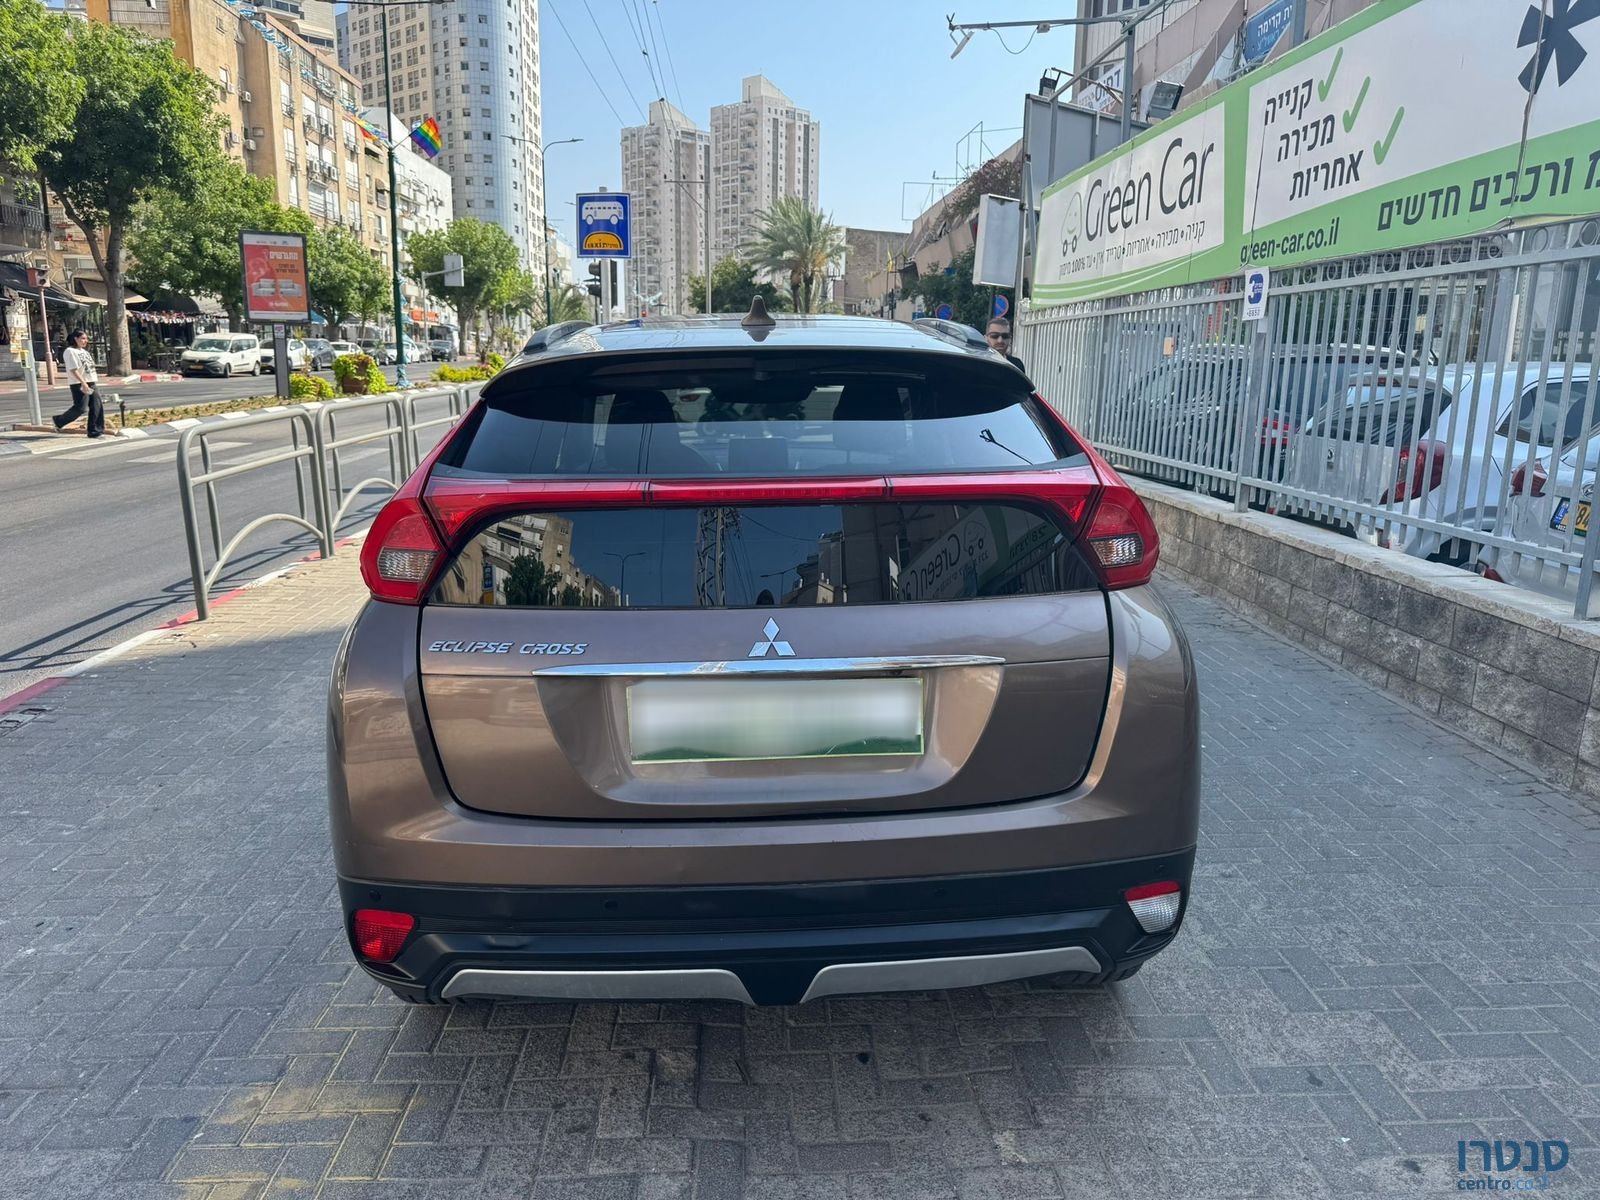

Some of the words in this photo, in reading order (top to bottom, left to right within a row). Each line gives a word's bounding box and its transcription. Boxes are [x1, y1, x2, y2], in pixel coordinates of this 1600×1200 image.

[1257, 11, 1282, 37] קדימה
[1264, 78, 1313, 126] קנייה
[1277, 114, 1335, 162] מכירה
[1085, 172, 1152, 242] Green
[1159, 137, 1215, 215] Car
[1289, 150, 1364, 201] אחריות
[1469, 157, 1574, 213] ורכבים
[1377, 184, 1461, 231] חדשים
[428, 640, 514, 654] ECLIPSE
[519, 643, 590, 655] CROSS
